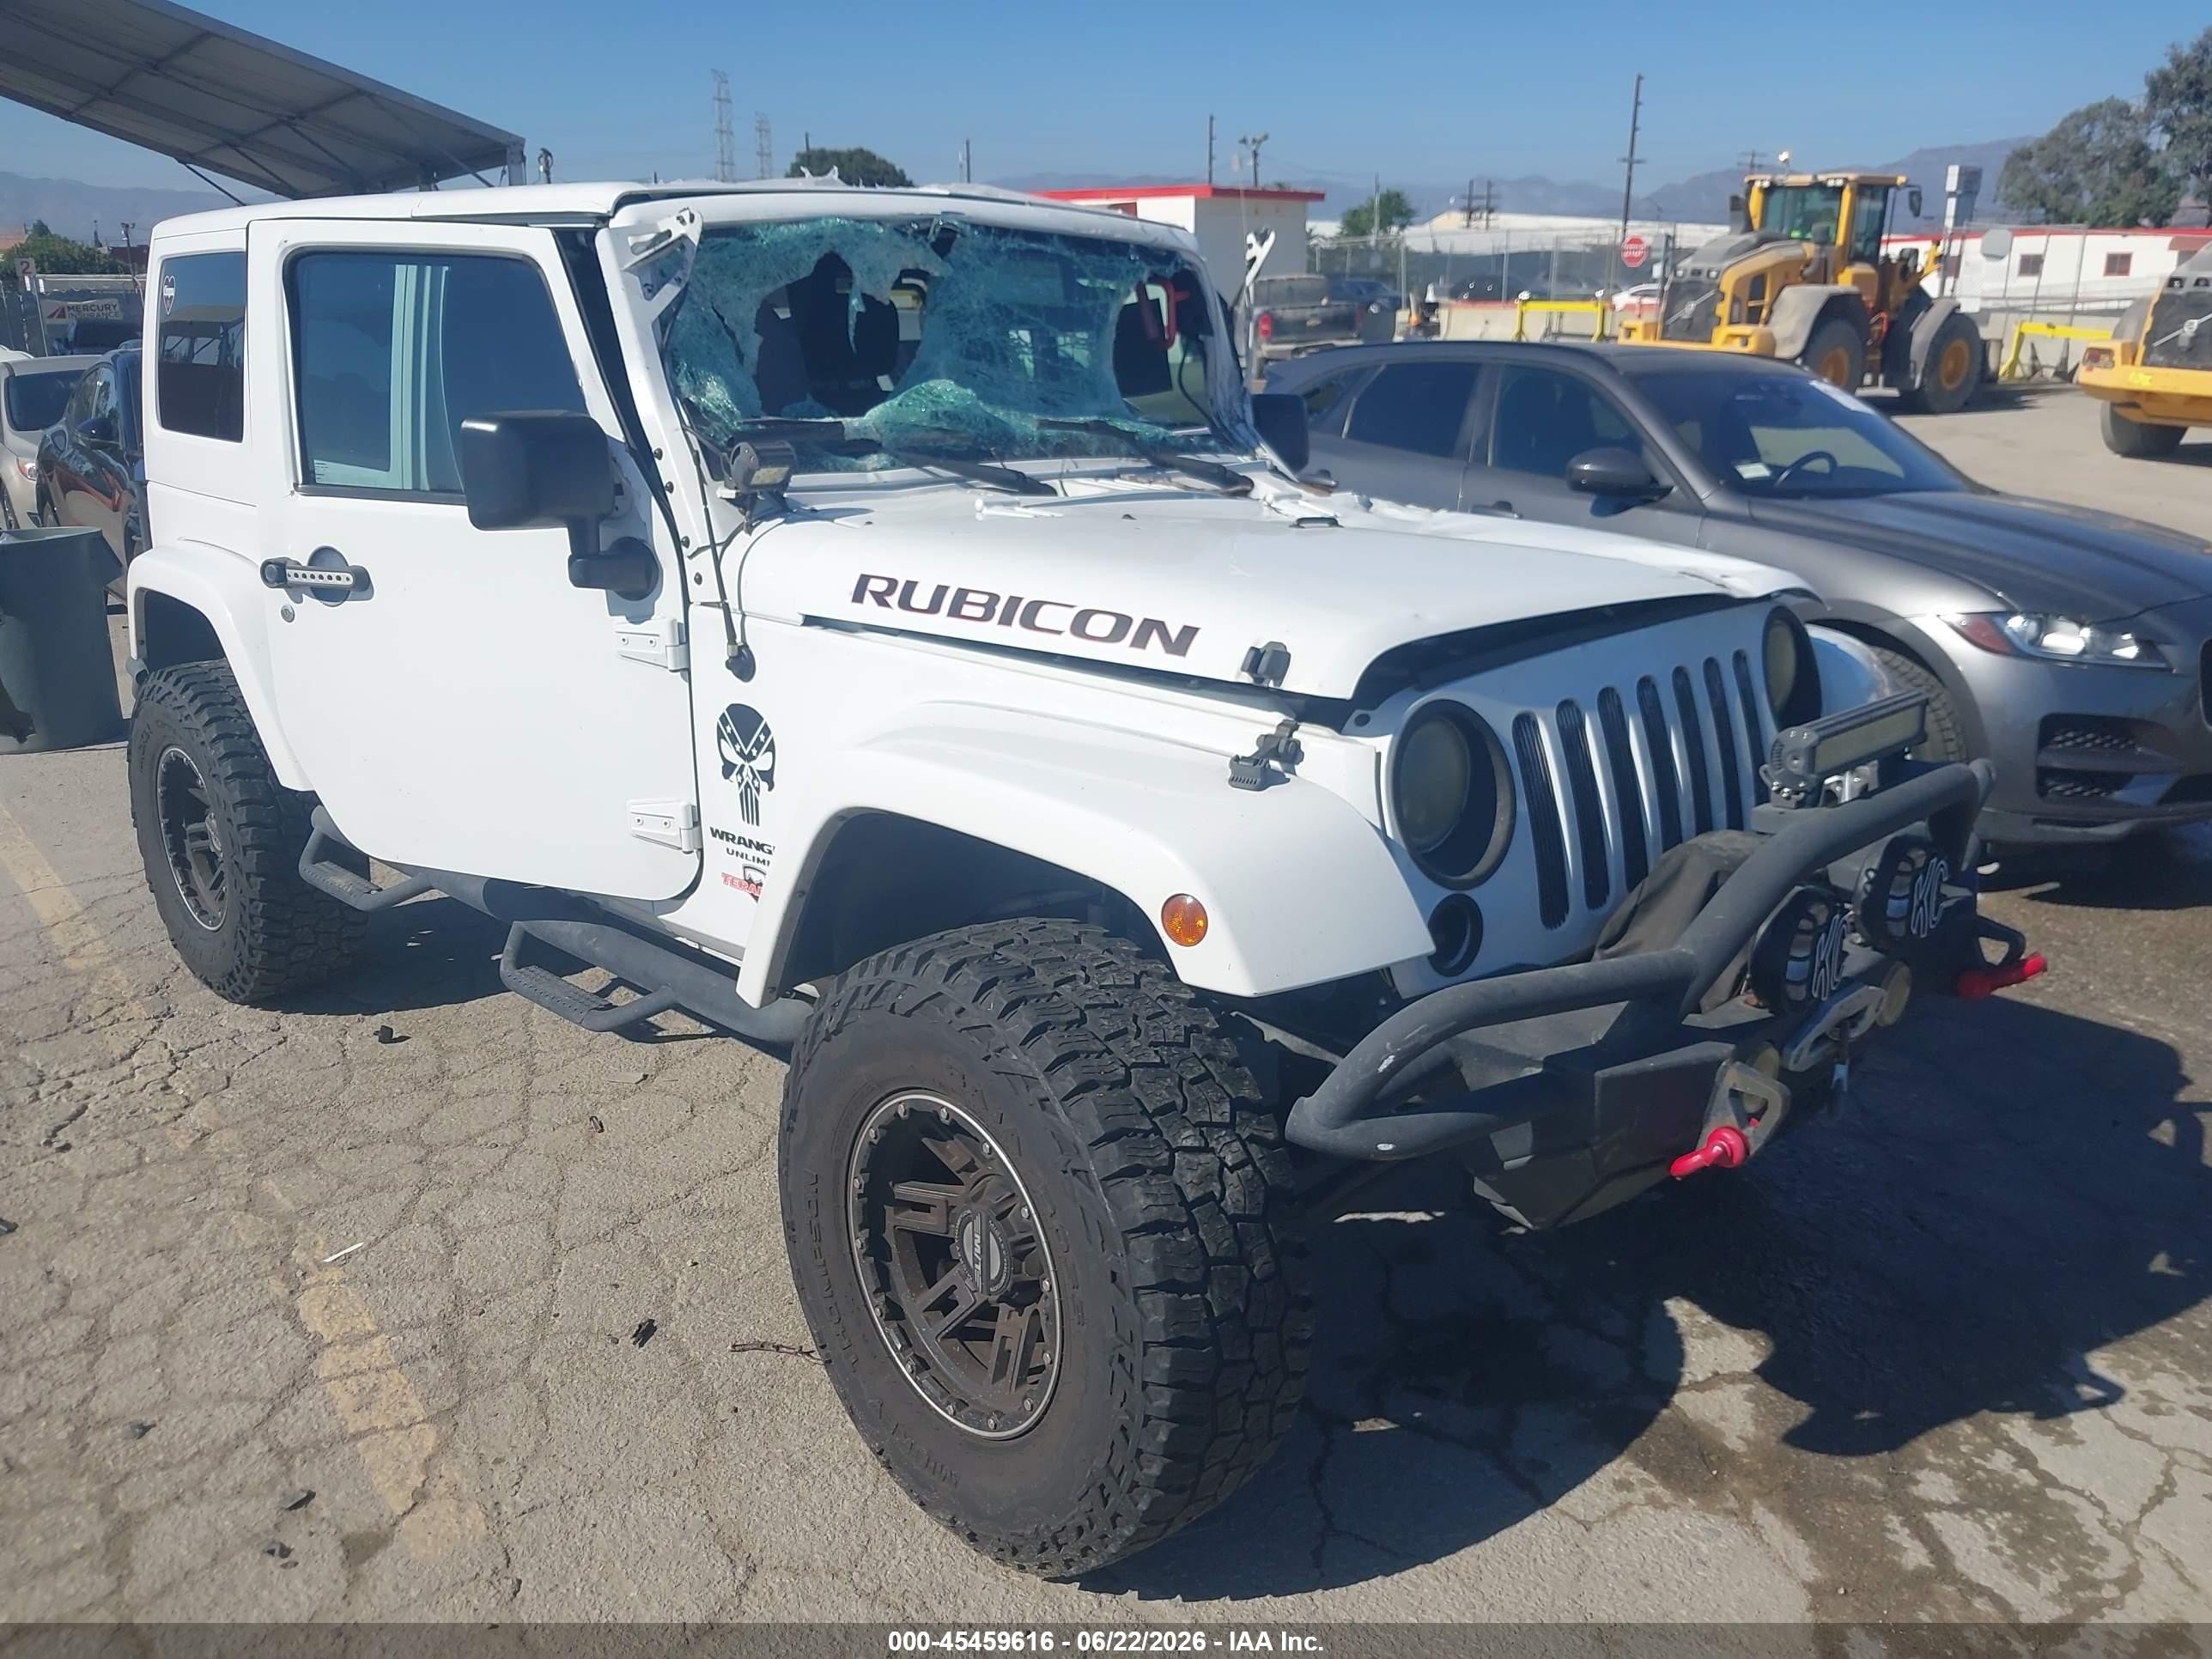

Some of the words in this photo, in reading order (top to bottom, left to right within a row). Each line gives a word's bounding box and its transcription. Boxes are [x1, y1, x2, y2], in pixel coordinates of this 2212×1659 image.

[20, 260, 32, 275] 2
[68, 302, 118, 313] MERCURY
[851, 573, 1201, 658] RUBICON
[1910, 855, 1952, 939] KC
[1811, 912, 1853, 1003] KC
